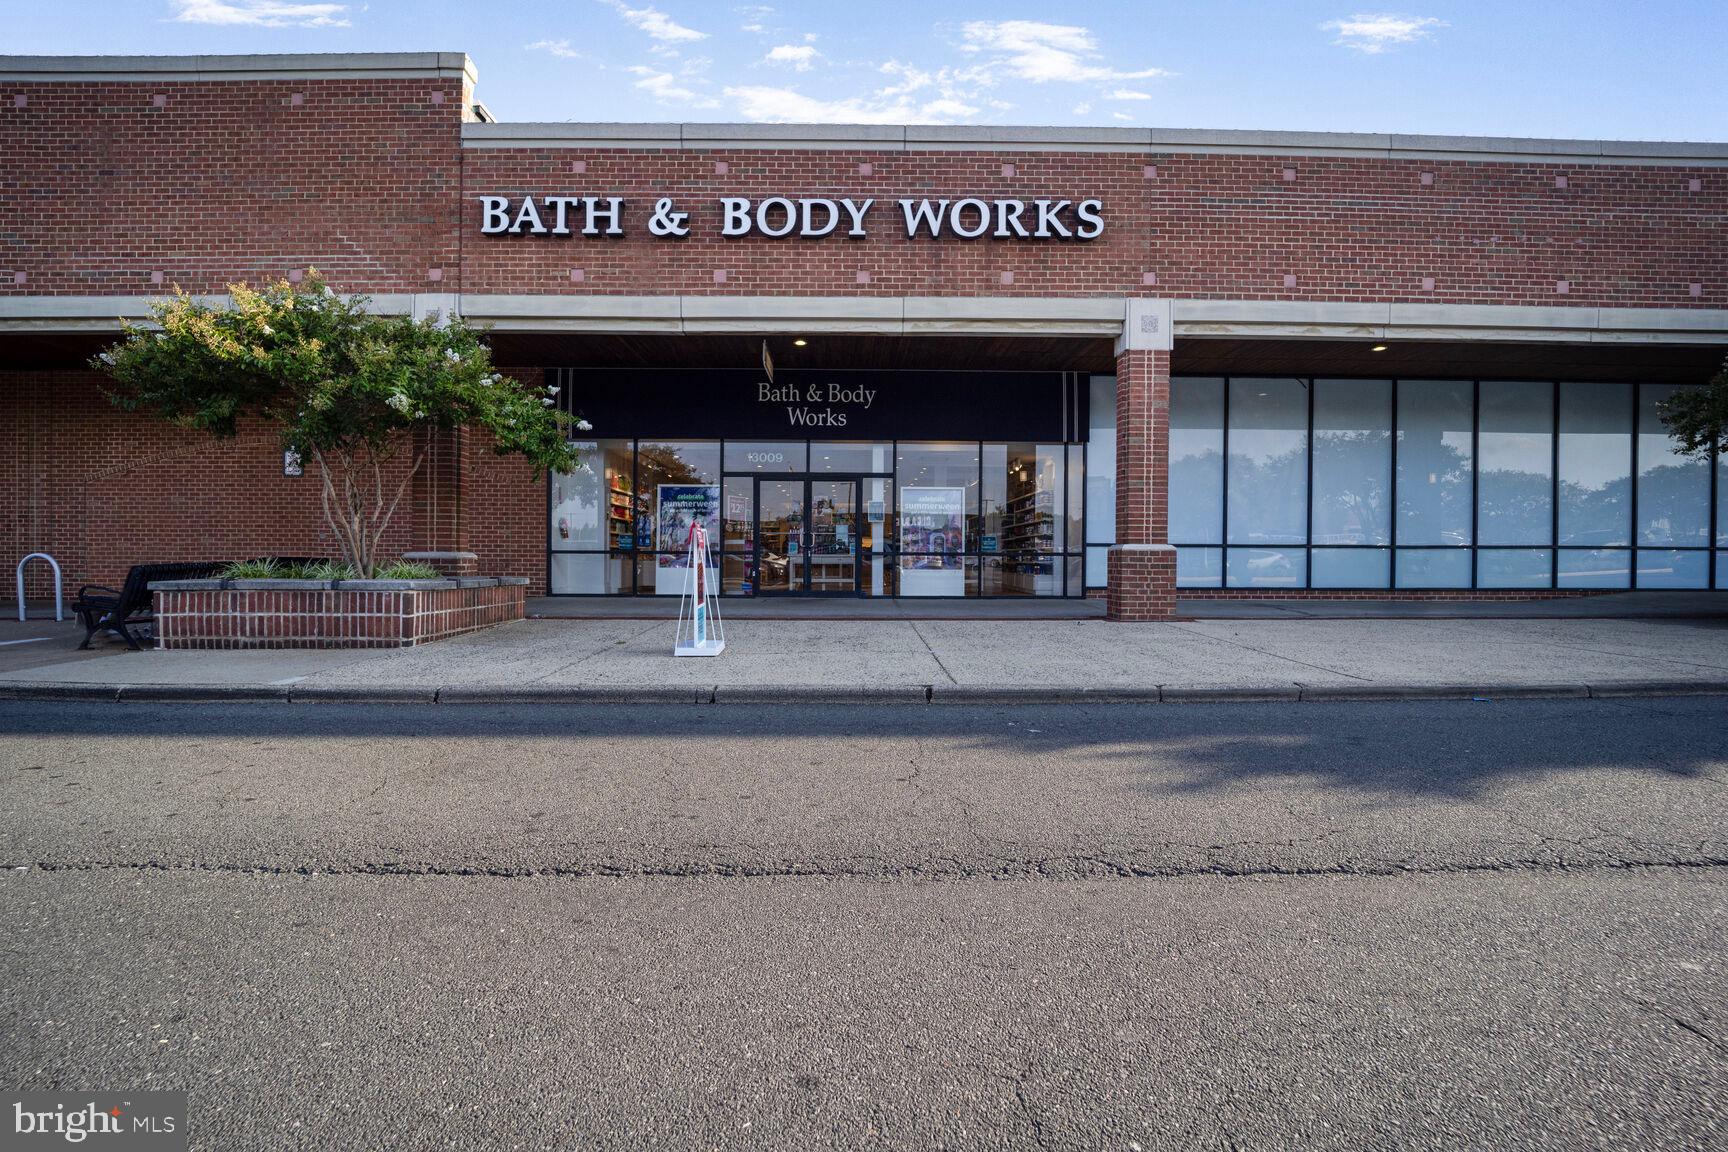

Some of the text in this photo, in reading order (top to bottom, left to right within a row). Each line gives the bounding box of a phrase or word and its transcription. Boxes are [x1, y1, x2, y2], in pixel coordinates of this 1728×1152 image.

[480, 196, 1104, 239] BATH & BODY WORKS
[758, 382, 876, 409] Bath & Body
[787, 406, 847, 426] Works
